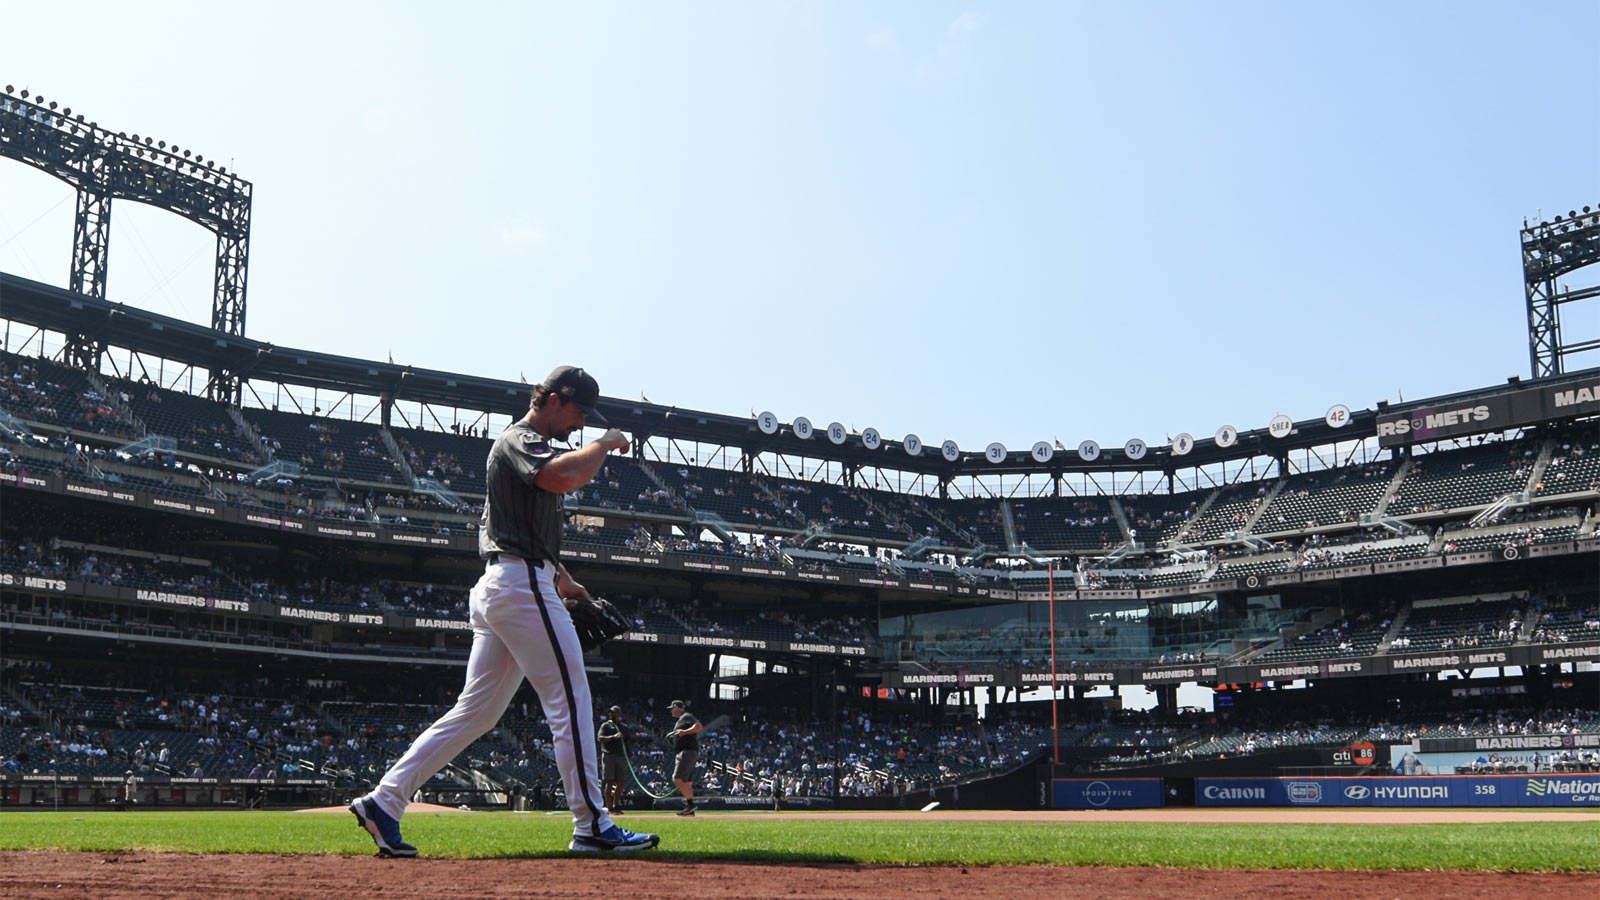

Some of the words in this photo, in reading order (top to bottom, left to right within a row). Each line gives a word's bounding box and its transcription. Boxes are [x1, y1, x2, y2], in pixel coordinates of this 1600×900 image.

[1330, 411, 1345, 422] 42
[1426, 405, 1490, 429] METS
[764, 417, 771, 428] 5
[798, 423, 807, 433] 18
[1271, 423, 1290, 432] SHEA
[832, 428, 842, 439] 16
[865, 432, 877, 444] 24
[908, 438, 917, 450] 17
[1129, 443, 1143, 454] 37
[991, 447, 1001, 458] 31
[1037, 447, 1048, 457] 41
[1084, 445, 1094, 456] 14
[24, 577, 67, 591] METS
[137, 589, 206, 607] MARINERS
[214, 601, 249, 612] METS
[280, 606, 341, 622] MARINERS
[348, 613, 384, 625] METS
[629, 632, 658, 642] METS
[684, 635, 734, 647] MARINERS
[740, 639, 767, 649] METS
[790, 642, 836, 653] MARINERS
[841, 646, 866, 655] METS
[1393, 656, 1460, 669] MARINERS
[1468, 652, 1507, 664] METS
[1142, 668, 1195, 680] MARINERS
[1201, 667, 1217, 676] ME
[1260, 665, 1320, 678] MARINERS
[1328, 662, 1362, 674] METS
[903, 673, 958, 683] MARINERS
[964, 673, 994, 682] METS
[1021, 672, 1078, 682] MARINERS
[1084, 672, 1114, 681] METS
[1476, 736, 1562, 750] MARINERS
[1333, 750, 1351, 761] citi
[1360, 748, 1373, 758] 86
[1204, 786, 1265, 799] Canon
[1374, 786, 1449, 799] HYUNDAI
[1474, 785, 1496, 795] 358
